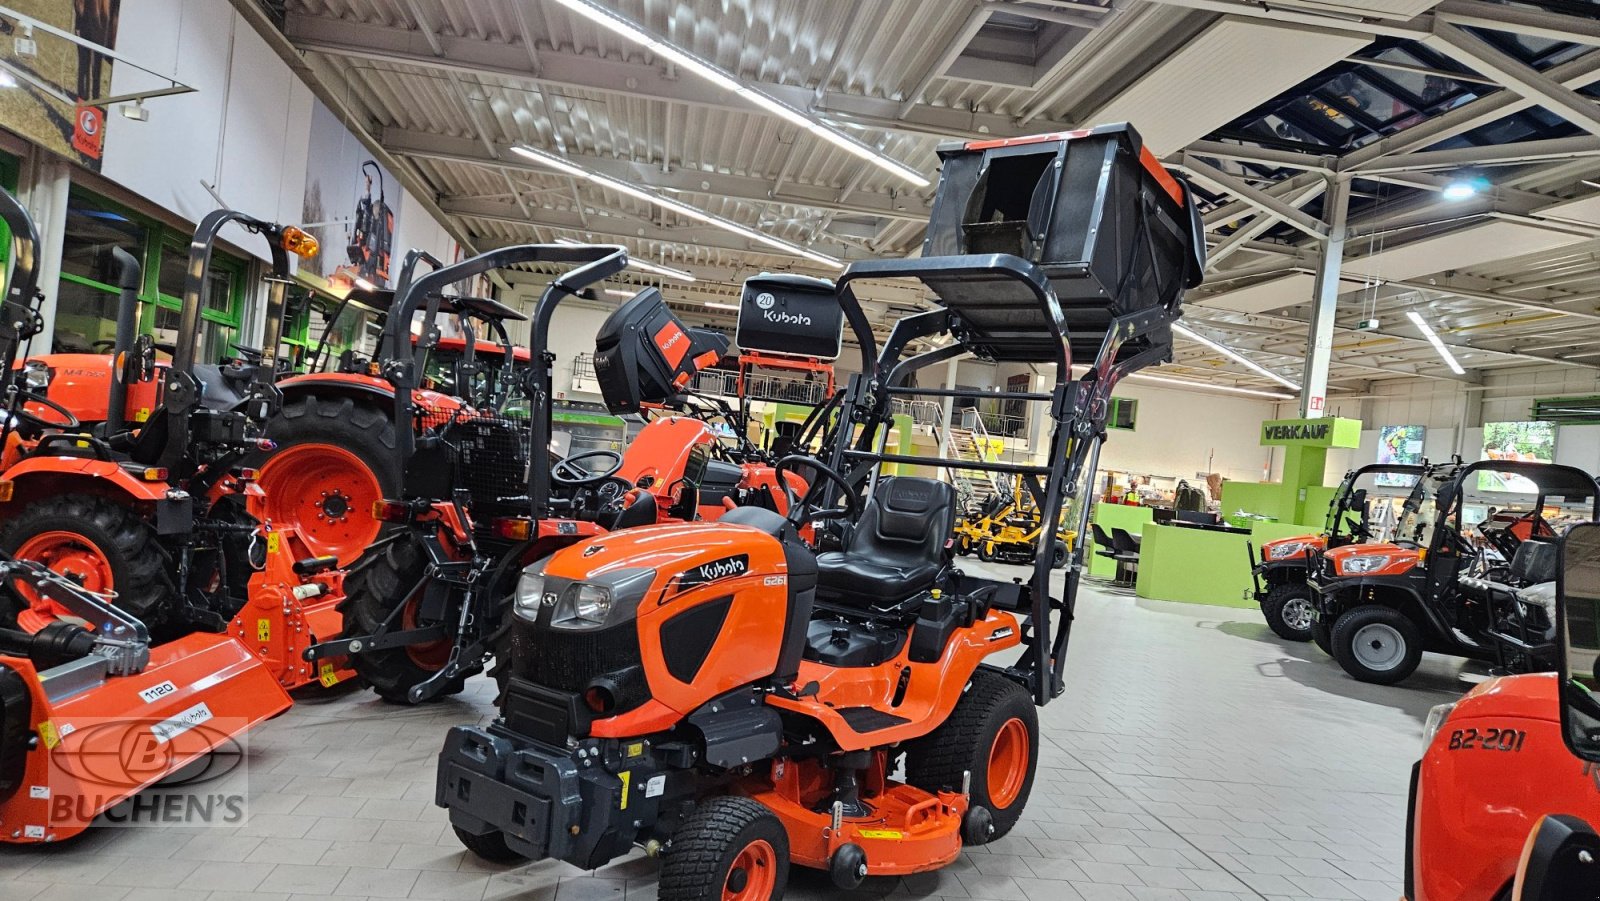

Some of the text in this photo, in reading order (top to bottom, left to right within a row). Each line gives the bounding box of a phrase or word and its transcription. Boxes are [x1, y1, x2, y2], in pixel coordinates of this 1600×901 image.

[760, 295, 772, 305] 20
[763, 310, 811, 325] Kubota
[662, 331, 682, 349] Kubota
[1265, 425, 1329, 440] VERKAUF
[699, 558, 745, 579] Kubota
[145, 683, 174, 699] 1120
[1448, 728, 1527, 752] B2-201
